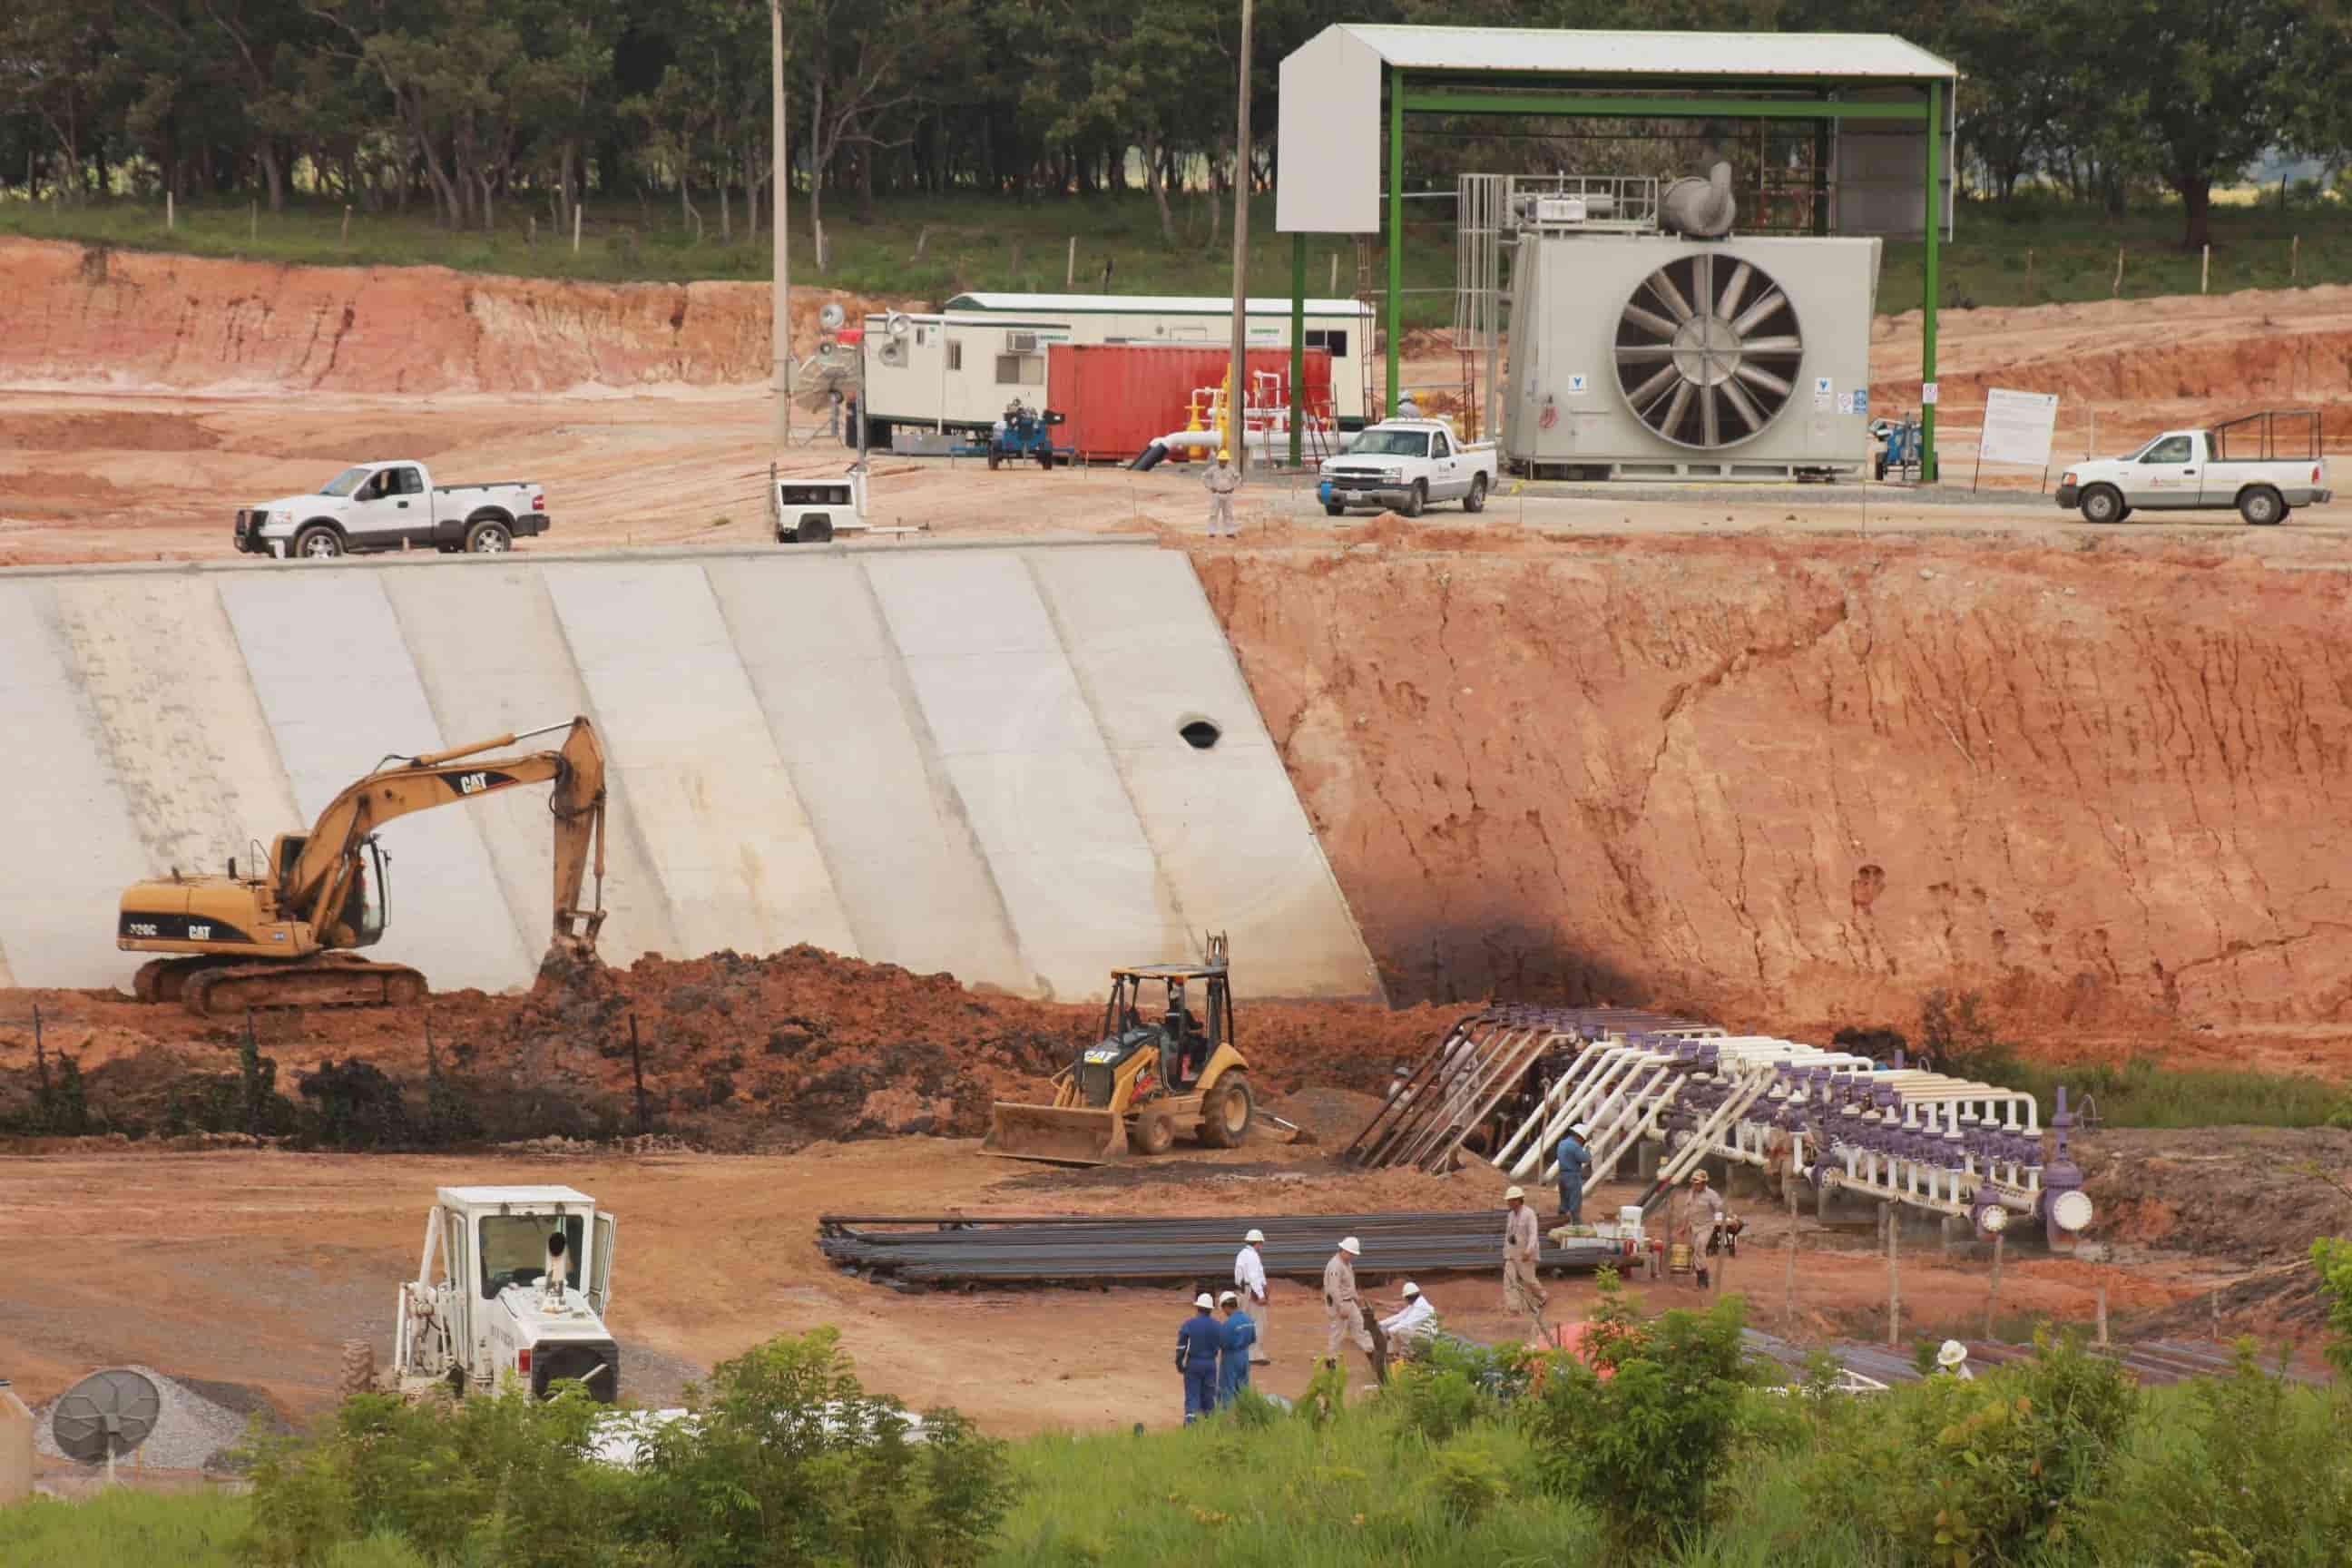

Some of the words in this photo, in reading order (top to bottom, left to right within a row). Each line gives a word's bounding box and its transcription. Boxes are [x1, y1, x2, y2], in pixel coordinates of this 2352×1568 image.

[460, 772, 487, 794] CAT
[188, 925, 211, 940] CAT
[1083, 1049, 1119, 1063] CAT
